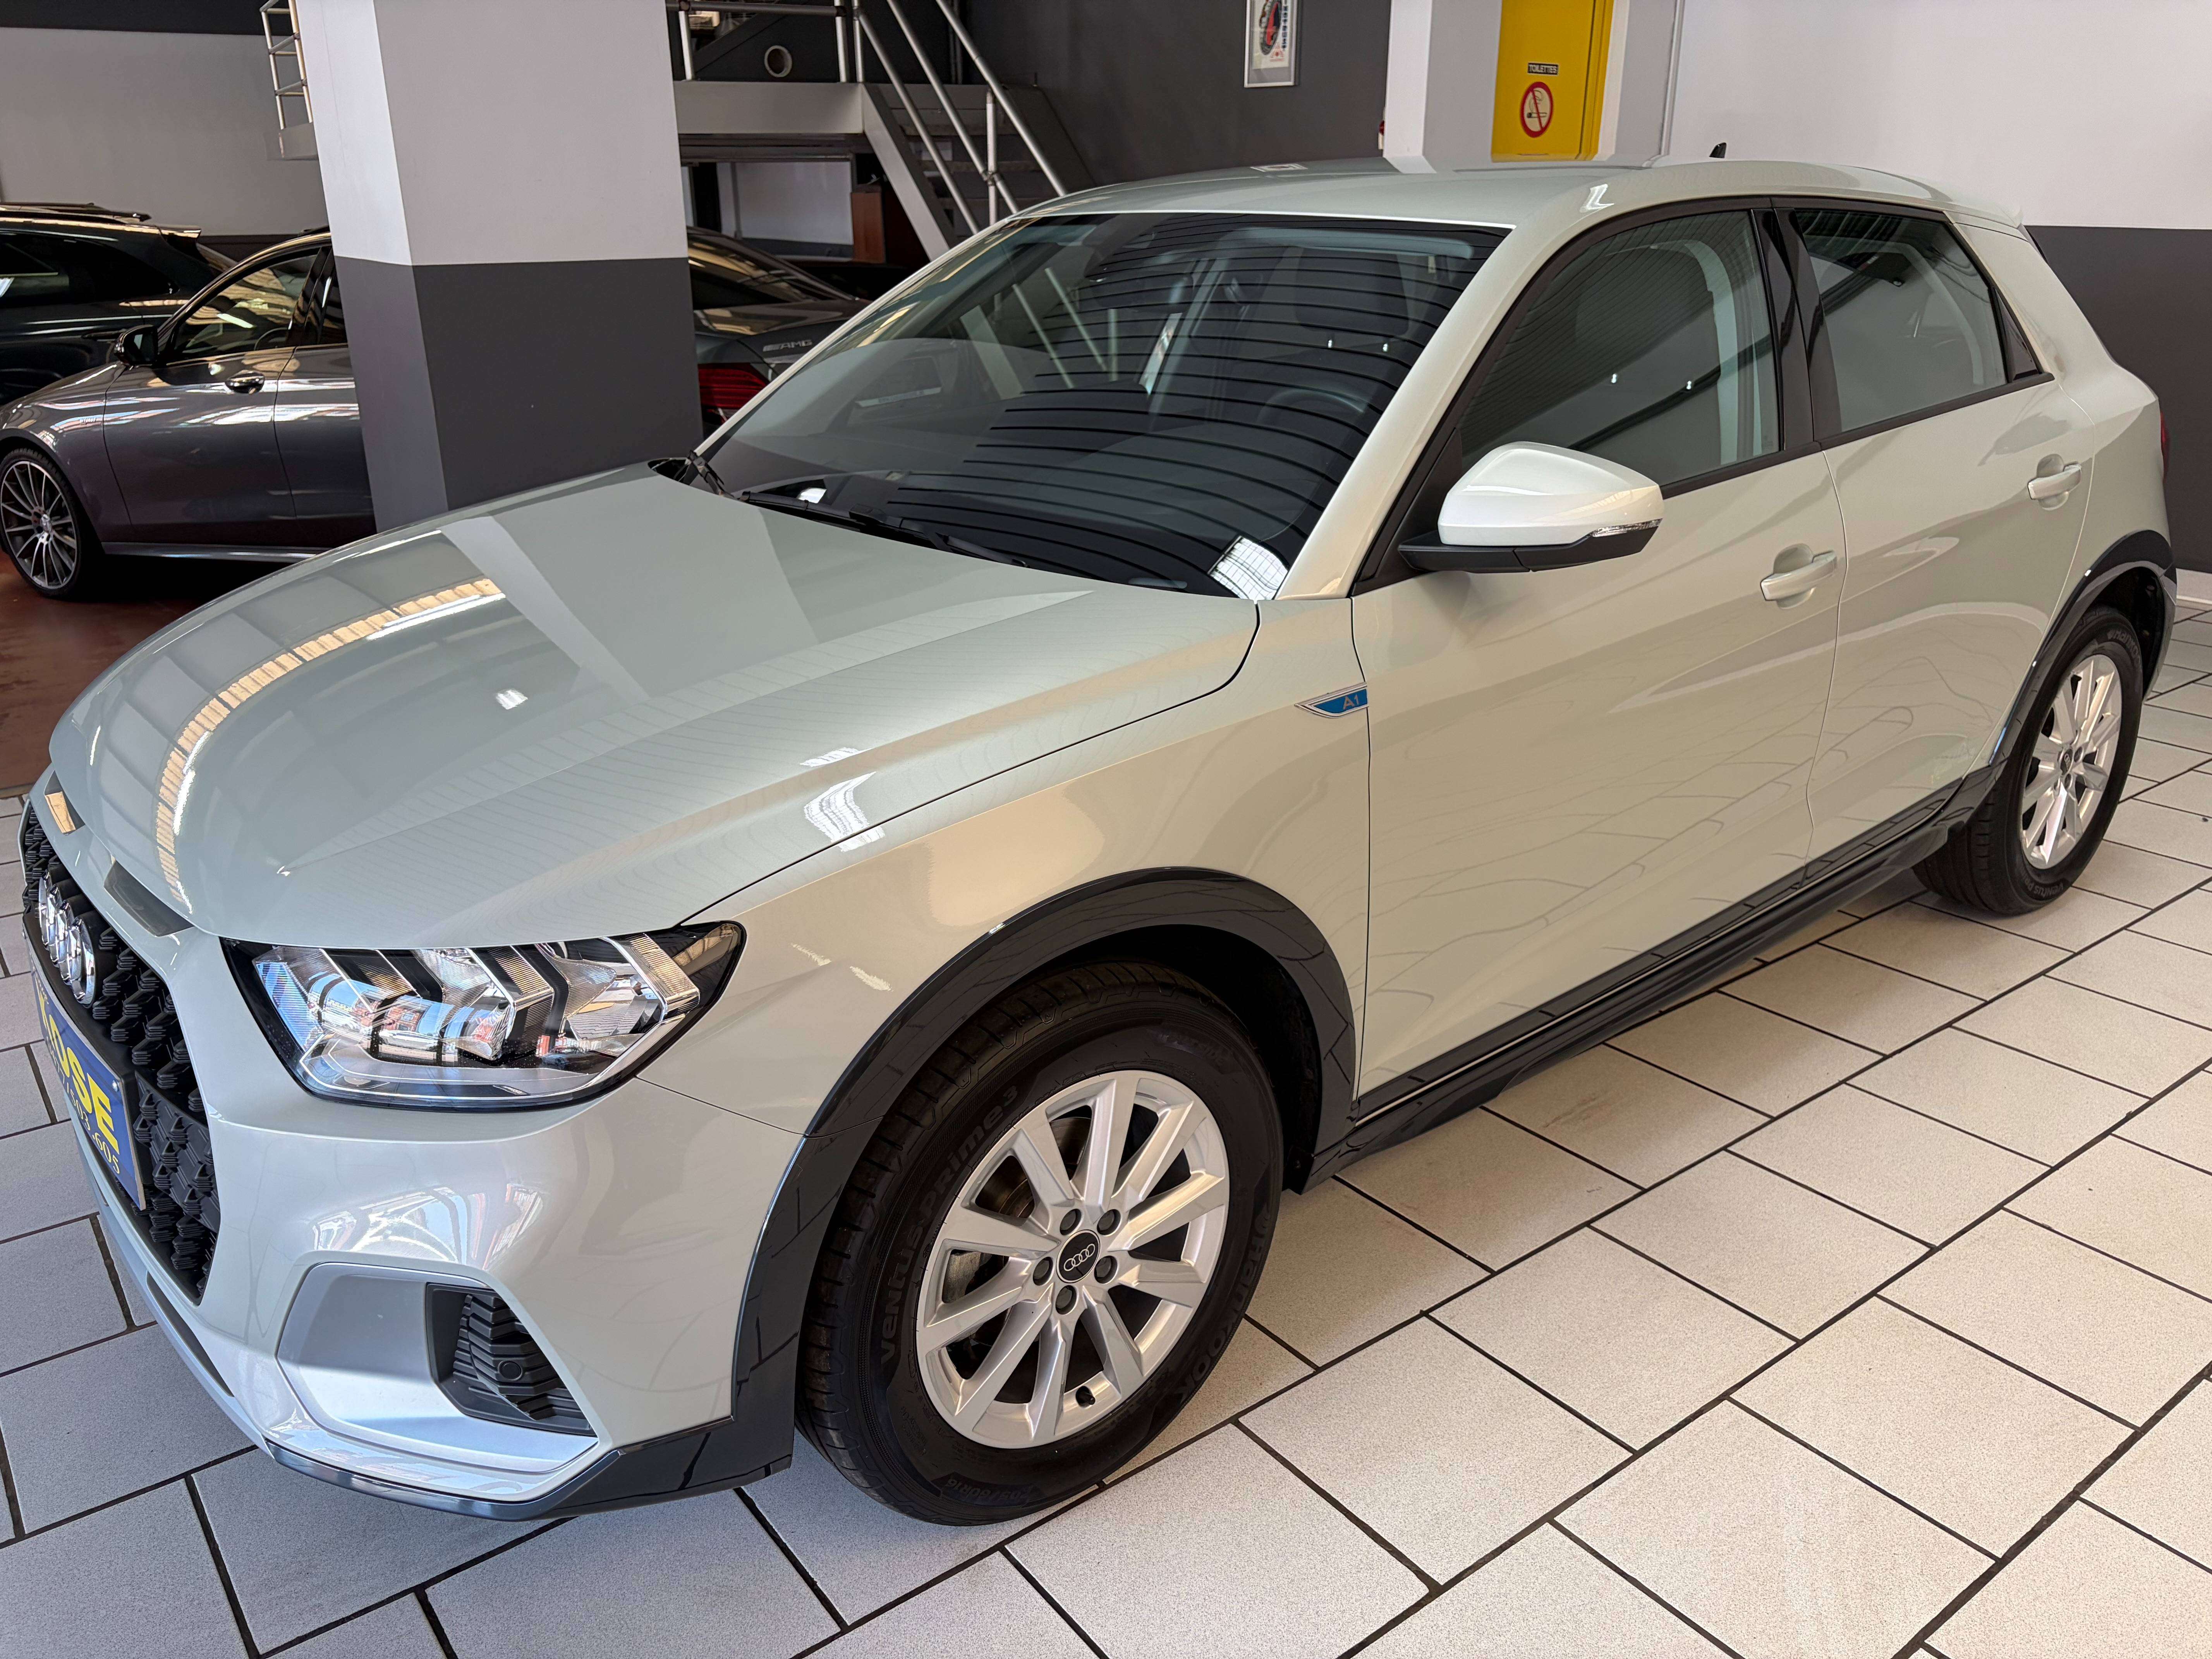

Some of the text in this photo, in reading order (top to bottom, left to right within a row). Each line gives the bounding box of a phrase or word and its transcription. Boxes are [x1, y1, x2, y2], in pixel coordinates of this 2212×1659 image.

[1528, 64, 1557, 73] TOILETTES
[780, 339, 812, 349] AMG
[1343, 694, 1359, 710] A1
